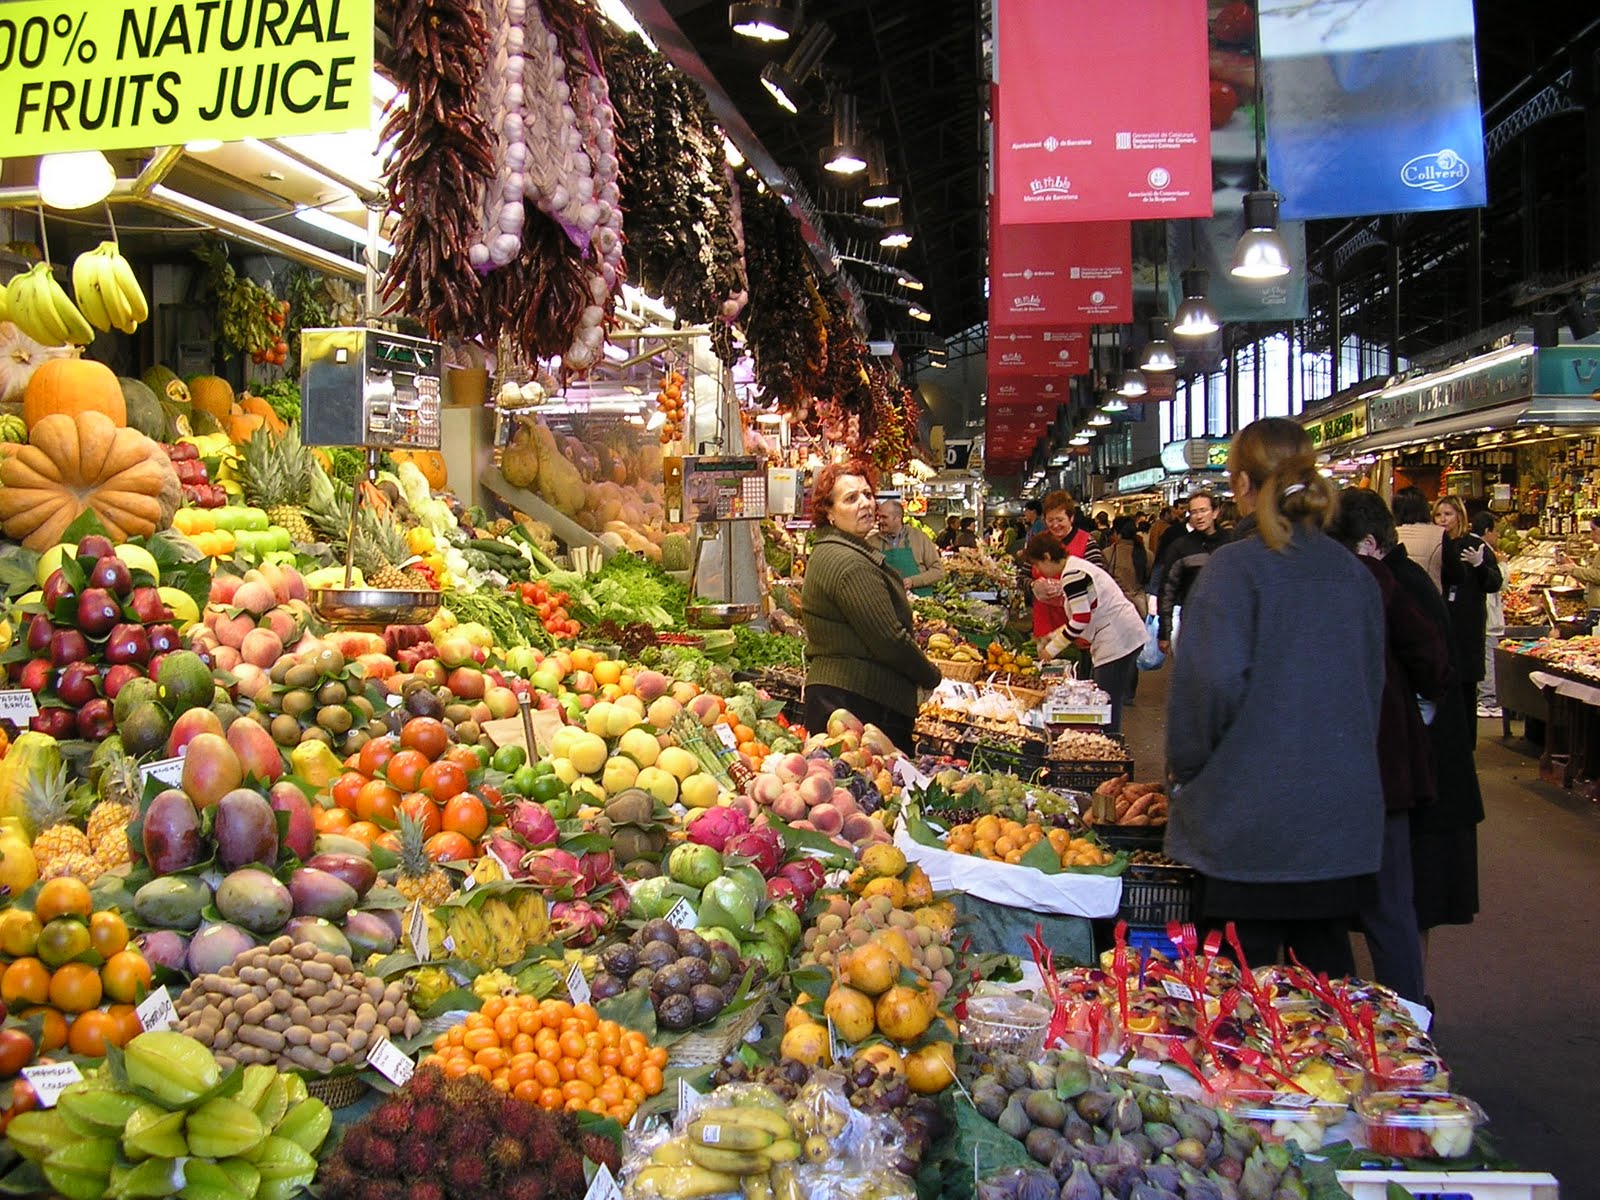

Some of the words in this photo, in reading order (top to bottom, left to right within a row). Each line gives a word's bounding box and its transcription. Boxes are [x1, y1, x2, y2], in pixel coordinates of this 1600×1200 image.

[116, 0, 350, 60] NATURAL
[15, 71, 182, 135] FRUITS
[198, 56, 356, 121] JUICE
[1404, 163, 1464, 181] Collverd
